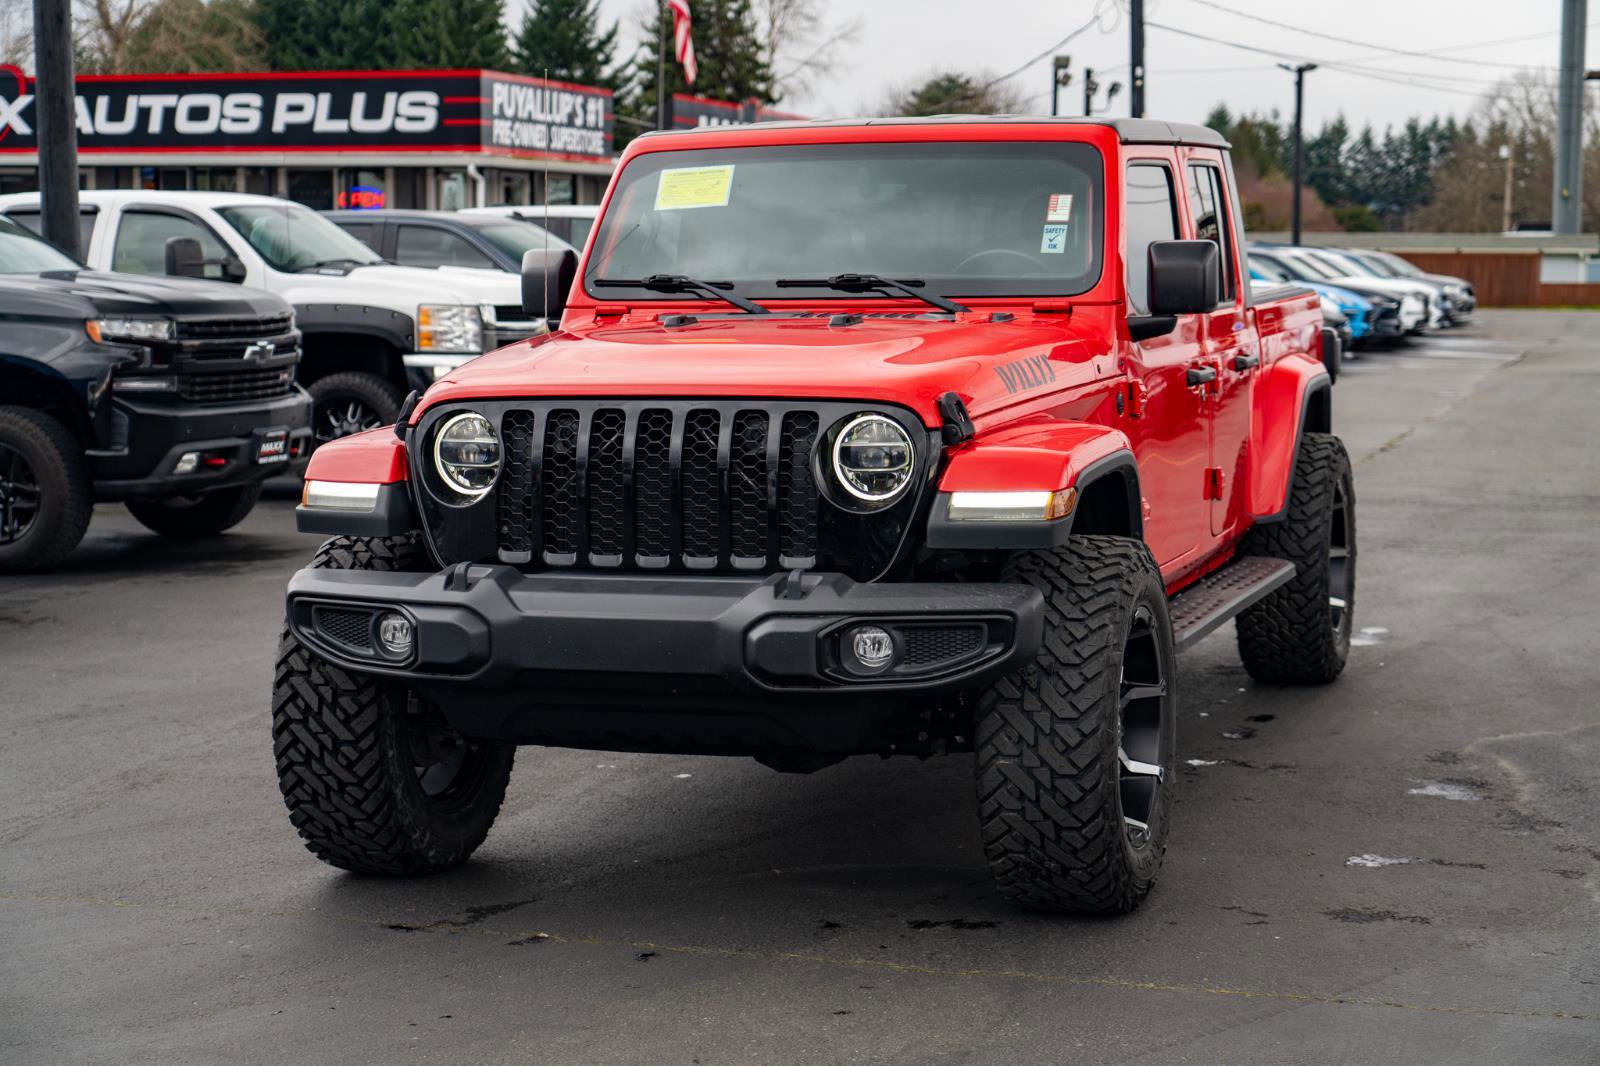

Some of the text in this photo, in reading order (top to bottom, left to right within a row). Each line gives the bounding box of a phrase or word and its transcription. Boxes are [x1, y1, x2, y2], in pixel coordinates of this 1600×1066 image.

[272, 90, 440, 135] PLUS
[492, 82, 605, 128] PUYALLUP'S #1
[492, 118, 605, 155] PRE-OWNED SUPERSTORE
[993, 354, 1056, 394] WILLYS
